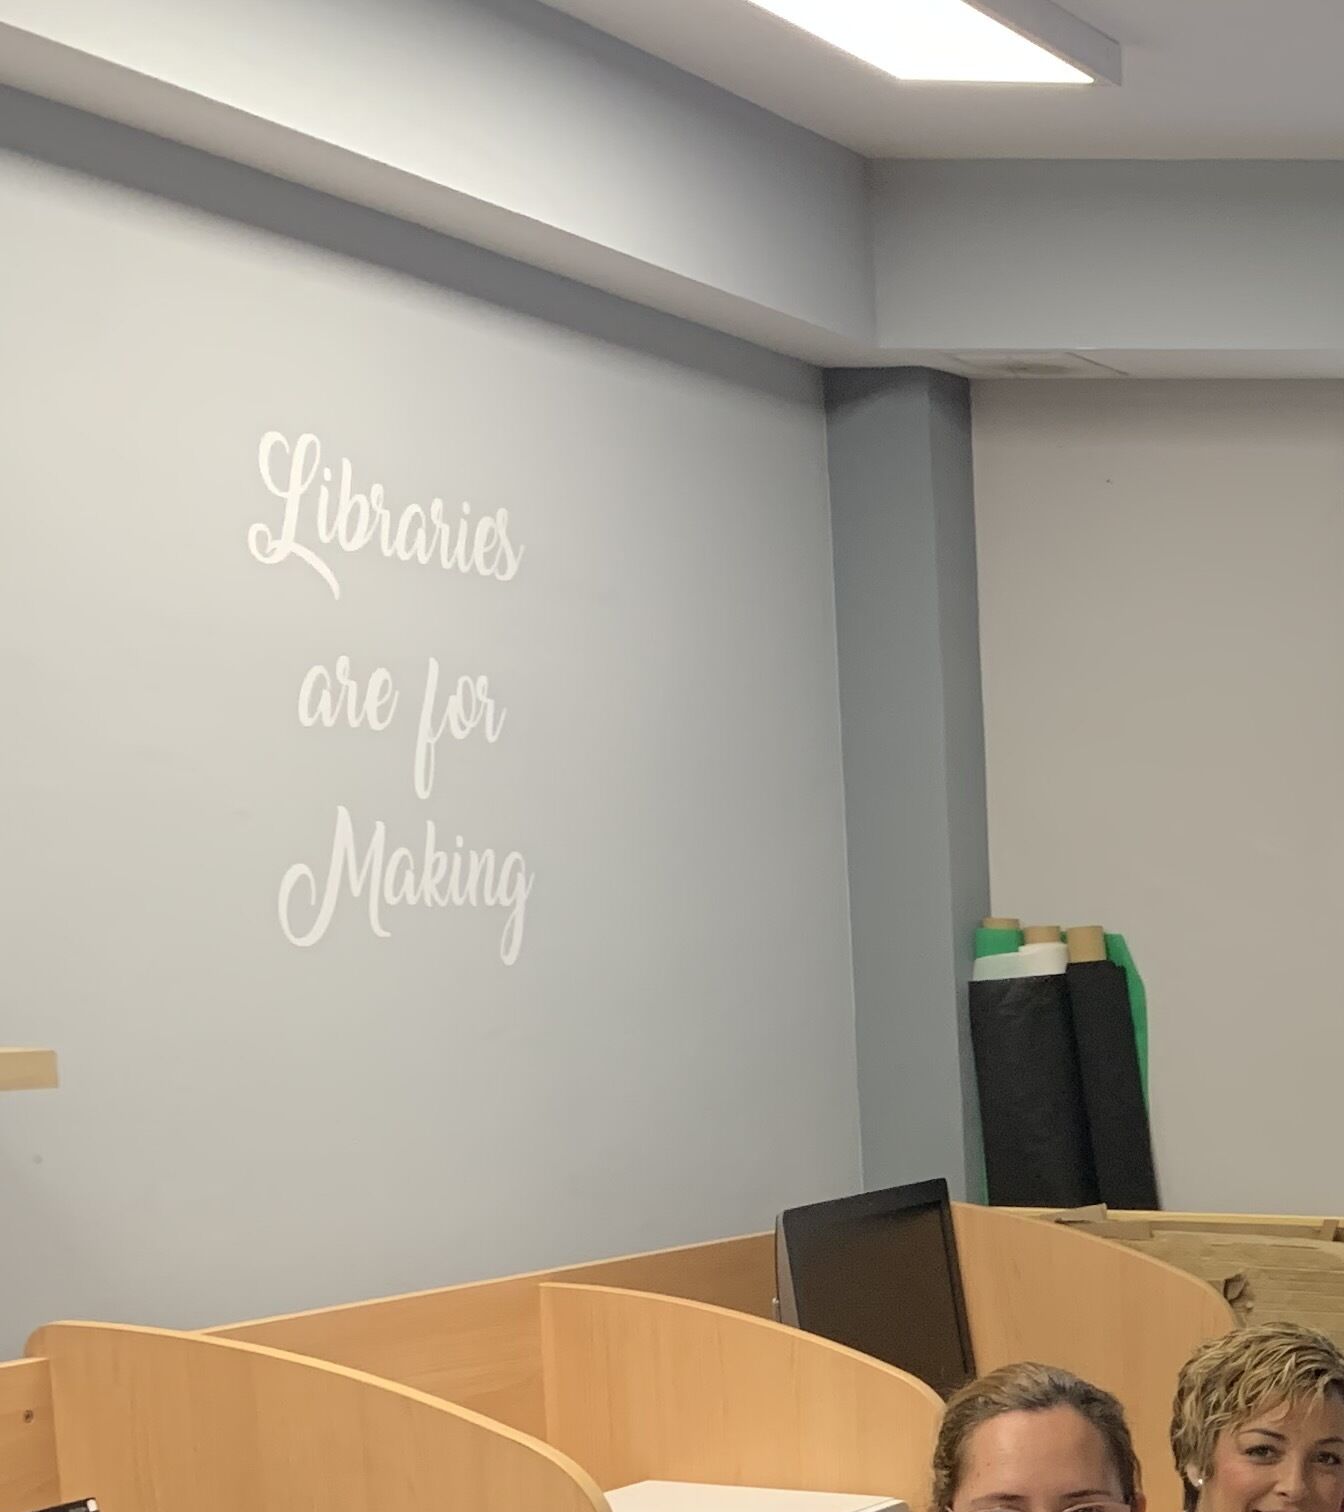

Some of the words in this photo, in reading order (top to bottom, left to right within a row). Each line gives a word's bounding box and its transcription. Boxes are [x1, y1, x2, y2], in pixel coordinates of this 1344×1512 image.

[248, 431, 524, 601] Libraries
[298, 655, 399, 731] are
[414, 656, 506, 800] for
[278, 805, 535, 966] Making
